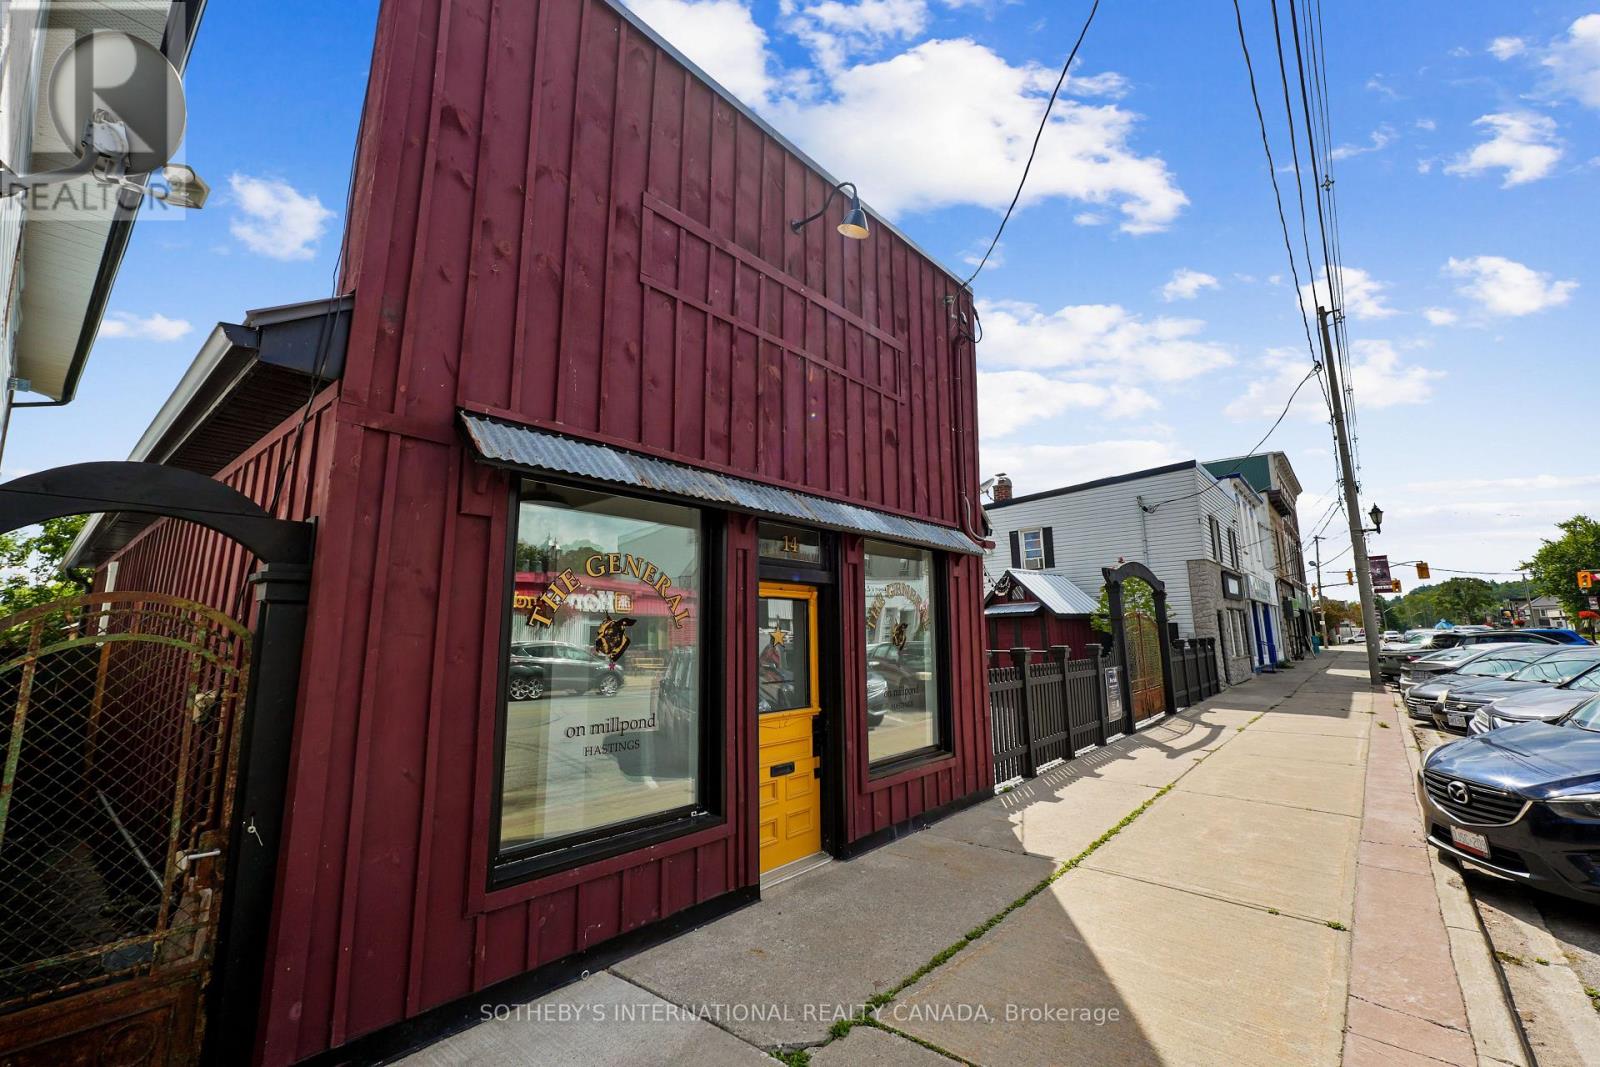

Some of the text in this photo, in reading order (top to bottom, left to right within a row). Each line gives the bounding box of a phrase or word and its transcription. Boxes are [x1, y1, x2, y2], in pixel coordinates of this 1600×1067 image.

[782, 535, 799, 552] 14
[528, 552, 691, 629] THE GENERAL
[566, 713, 656, 738] on millpond
[584, 739, 640, 756] HASTINGS
